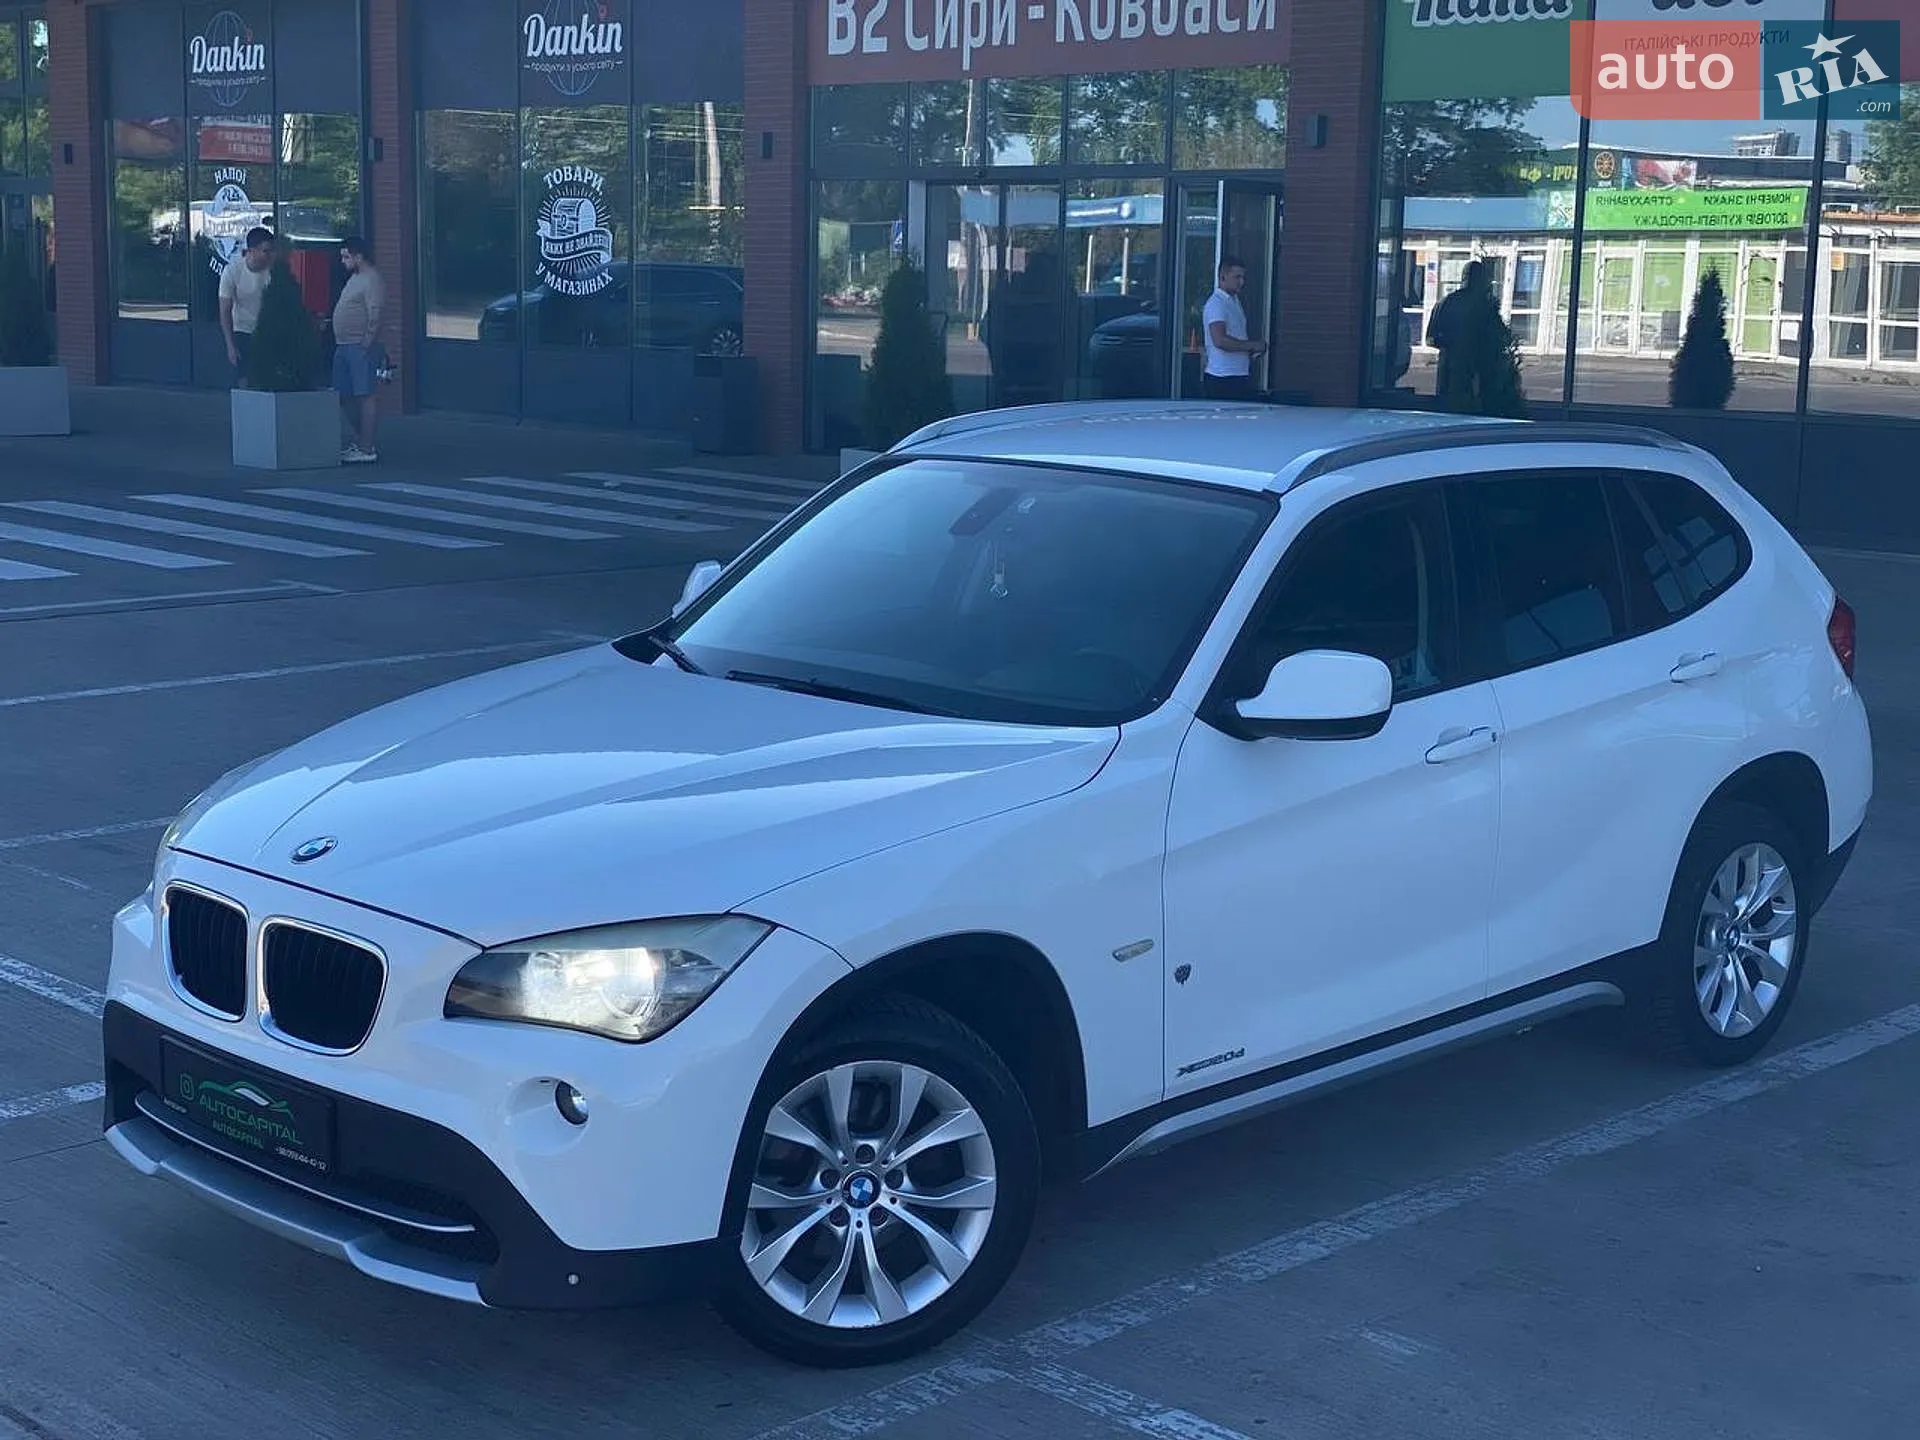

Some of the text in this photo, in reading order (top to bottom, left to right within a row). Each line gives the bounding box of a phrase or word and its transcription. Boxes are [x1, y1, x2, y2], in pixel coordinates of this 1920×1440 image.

[524, 13, 622, 57] Dankin
[1708, 29, 1790, 47] ПРОДУКТИ
[191, 36, 265, 73] Dankin
[535, 261, 613, 296] У МАГАЗИНАХ
[199, 1095, 304, 1145] AUTOCAPITAL
